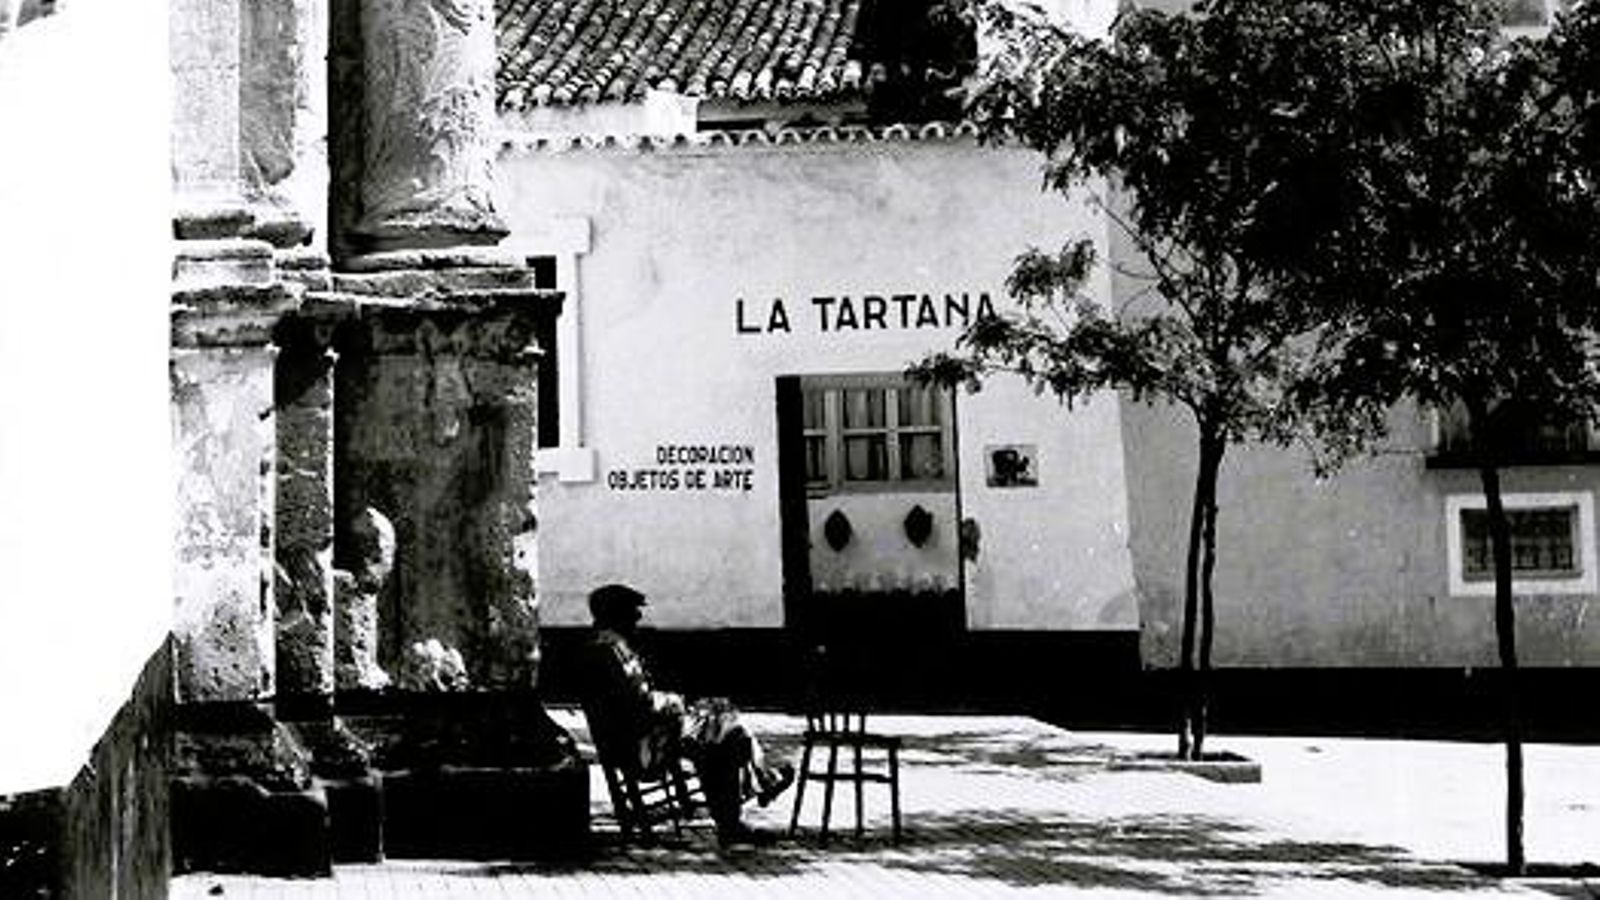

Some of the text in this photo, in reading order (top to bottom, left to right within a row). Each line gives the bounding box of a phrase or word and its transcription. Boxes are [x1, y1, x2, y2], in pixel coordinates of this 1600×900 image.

[736, 293, 997, 333] LA TARTANA
[607, 468, 754, 491] OBJETOS DE ARTE
